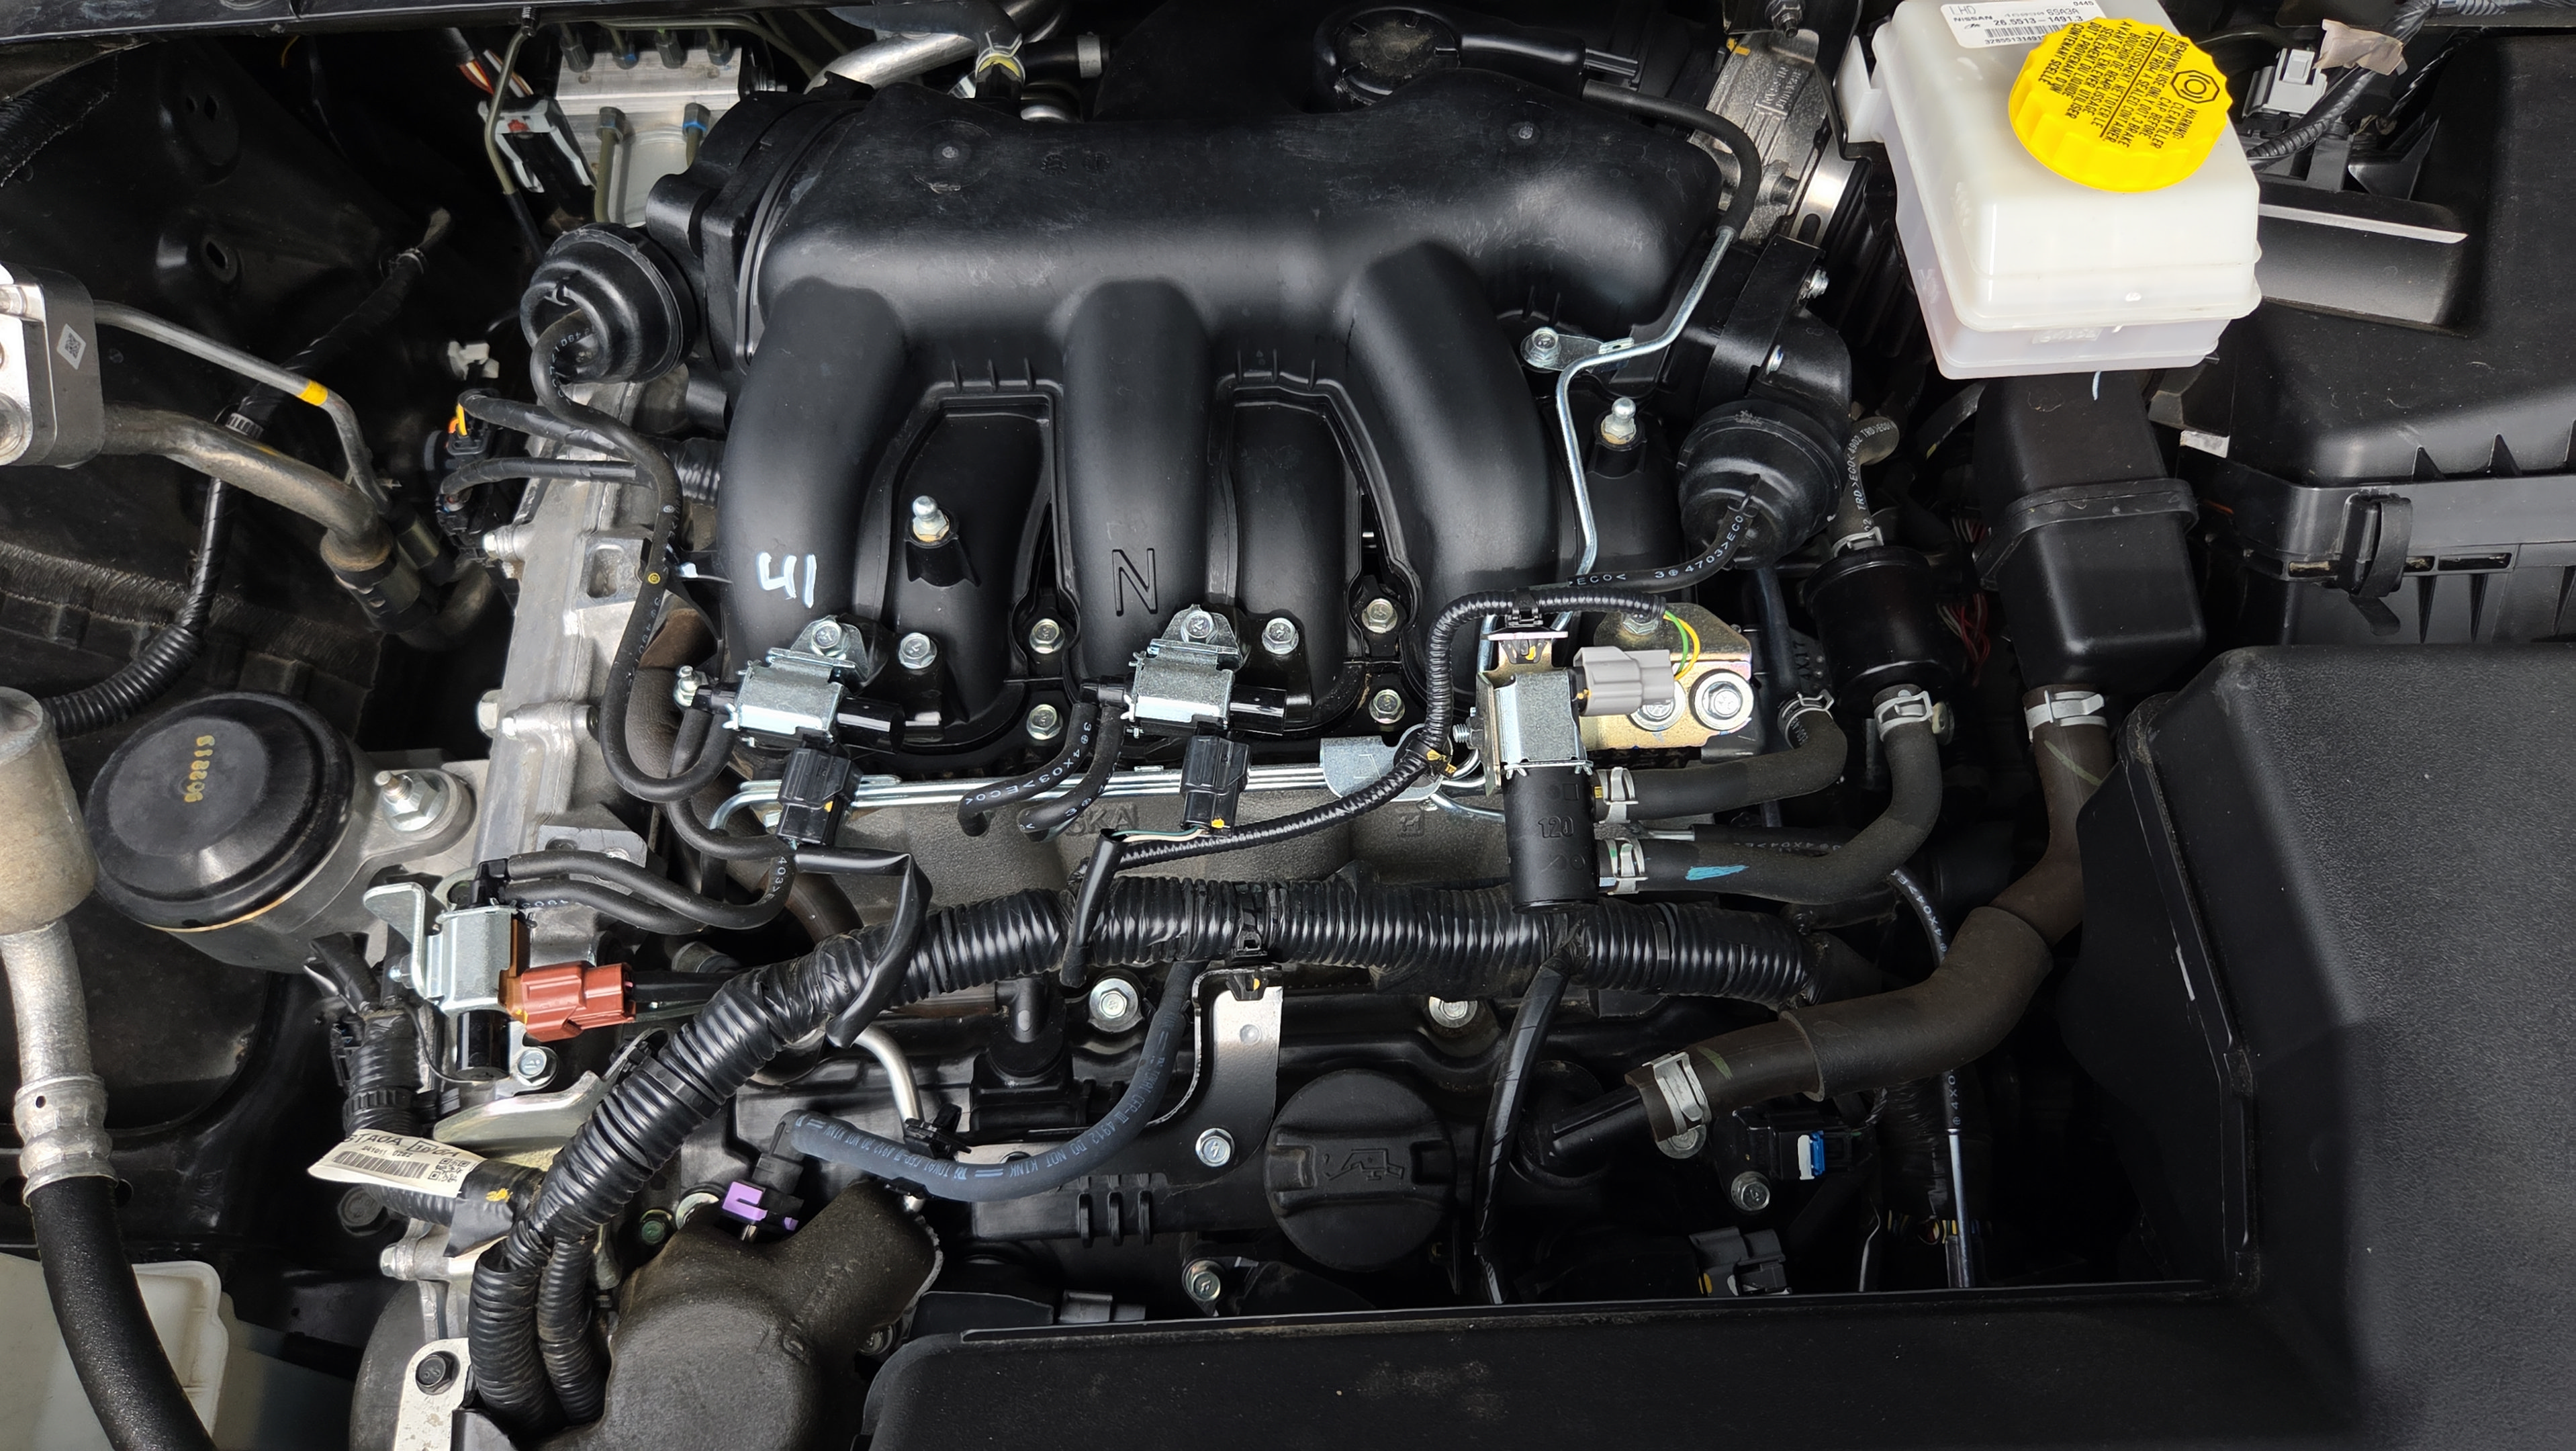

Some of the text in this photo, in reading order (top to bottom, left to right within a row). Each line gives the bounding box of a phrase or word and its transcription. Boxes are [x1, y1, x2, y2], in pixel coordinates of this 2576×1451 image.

[1949, 5, 1976, 15] LHD
[2085, 21, 2101, 36] DOT
[2111, 20, 2132, 44] AVANT
[2054, 22, 2084, 60] CONTENANT
[2105, 42, 2119, 54] DE
[2156, 34, 2176, 54] FLUID
[2059, 38, 2090, 78] PROVENANT
[2062, 26, 2113, 99] SEULEMENT DU LIQUIDE
[2145, 53, 2165, 74] FROM
[2082, 32, 2140, 116] BOUCHON DE REMPLISSAGE
[2152, 73, 2169, 88] USE
[2064, 88, 2091, 119] UTILISER
[2097, 83, 2125, 118] NETTOYER
[2125, 79, 2150, 106] SEALED
[2142, 85, 2162, 105] ONLY
[2134, 103, 2151, 118] DOT
[2138, 96, 2171, 139] CAP BEFORE
[2090, 117, 2105, 128] LE
[2148, 101, 2185, 149] CLEAN FILLER
[2170, 107, 2199, 141] WARNING:
[2117, 122, 2140, 148] BRAKE
[1111, 547, 1158, 615] N
[1538, 816, 1574, 838] 120
[844, 1135, 860, 1148] NOT
[1087, 1120, 1116, 1145] 4912
[1046, 1147, 1068, 1168] NOT
[1069, 1139, 1088, 1156] DO
[1009, 1159, 1039, 1178] KINK
